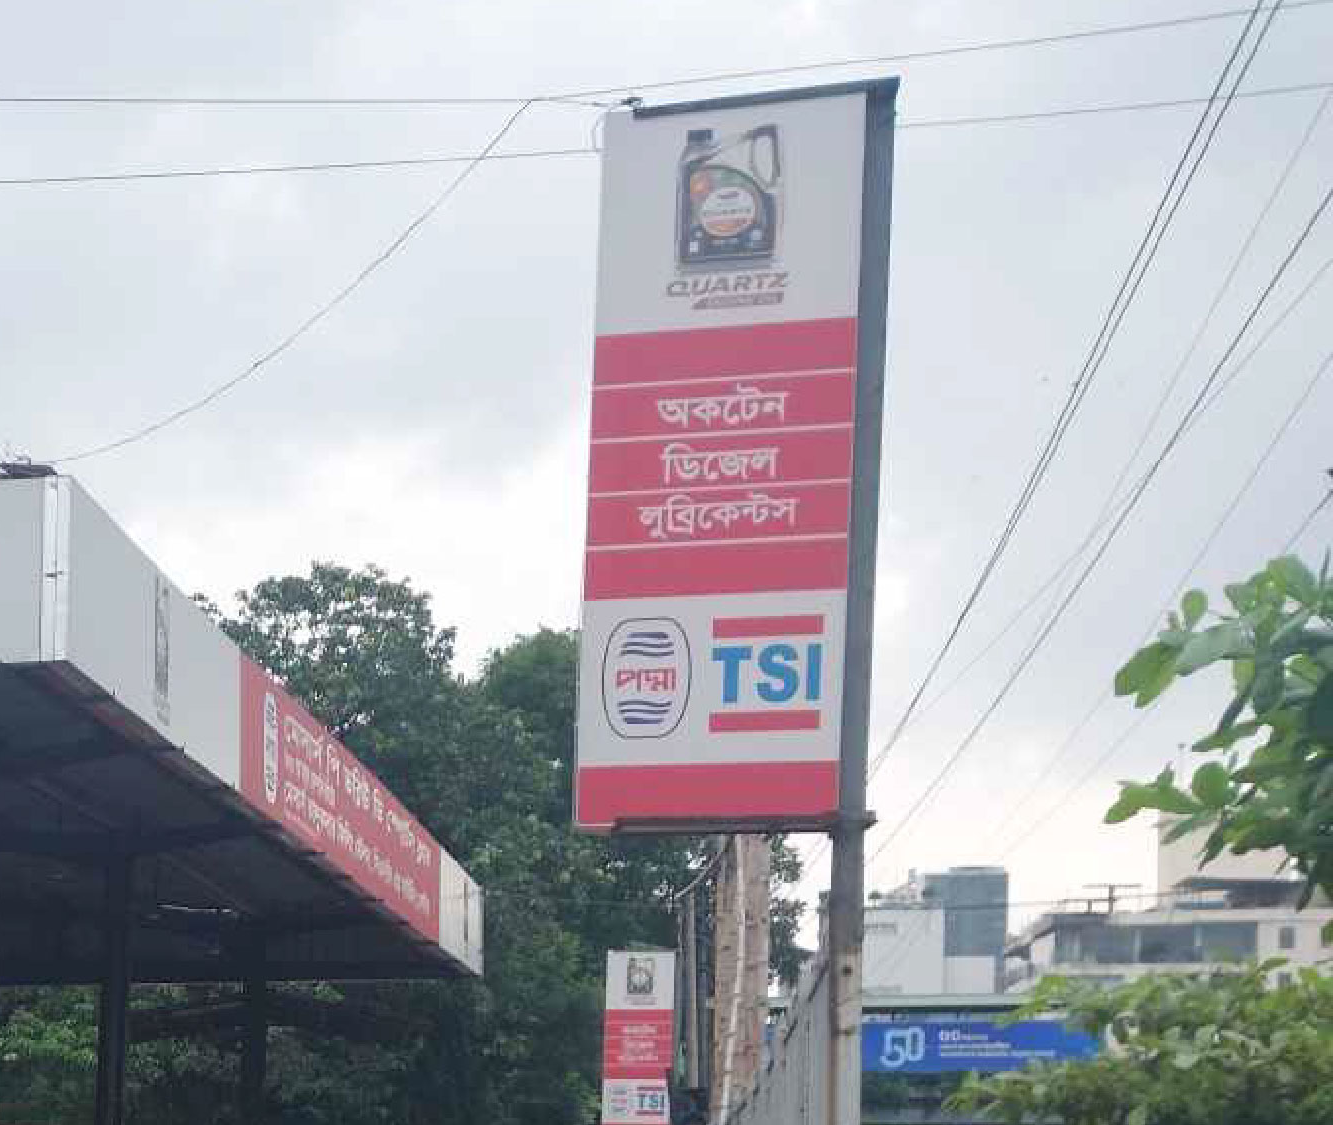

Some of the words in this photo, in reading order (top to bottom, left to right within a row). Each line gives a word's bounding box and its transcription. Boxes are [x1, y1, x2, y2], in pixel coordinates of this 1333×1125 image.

[667, 272, 789, 298] QUARTZ
[657, 382, 789, 427] অকটেন
[660, 443, 781, 484] ডিজেল
[711, 643, 822, 704] TSI
